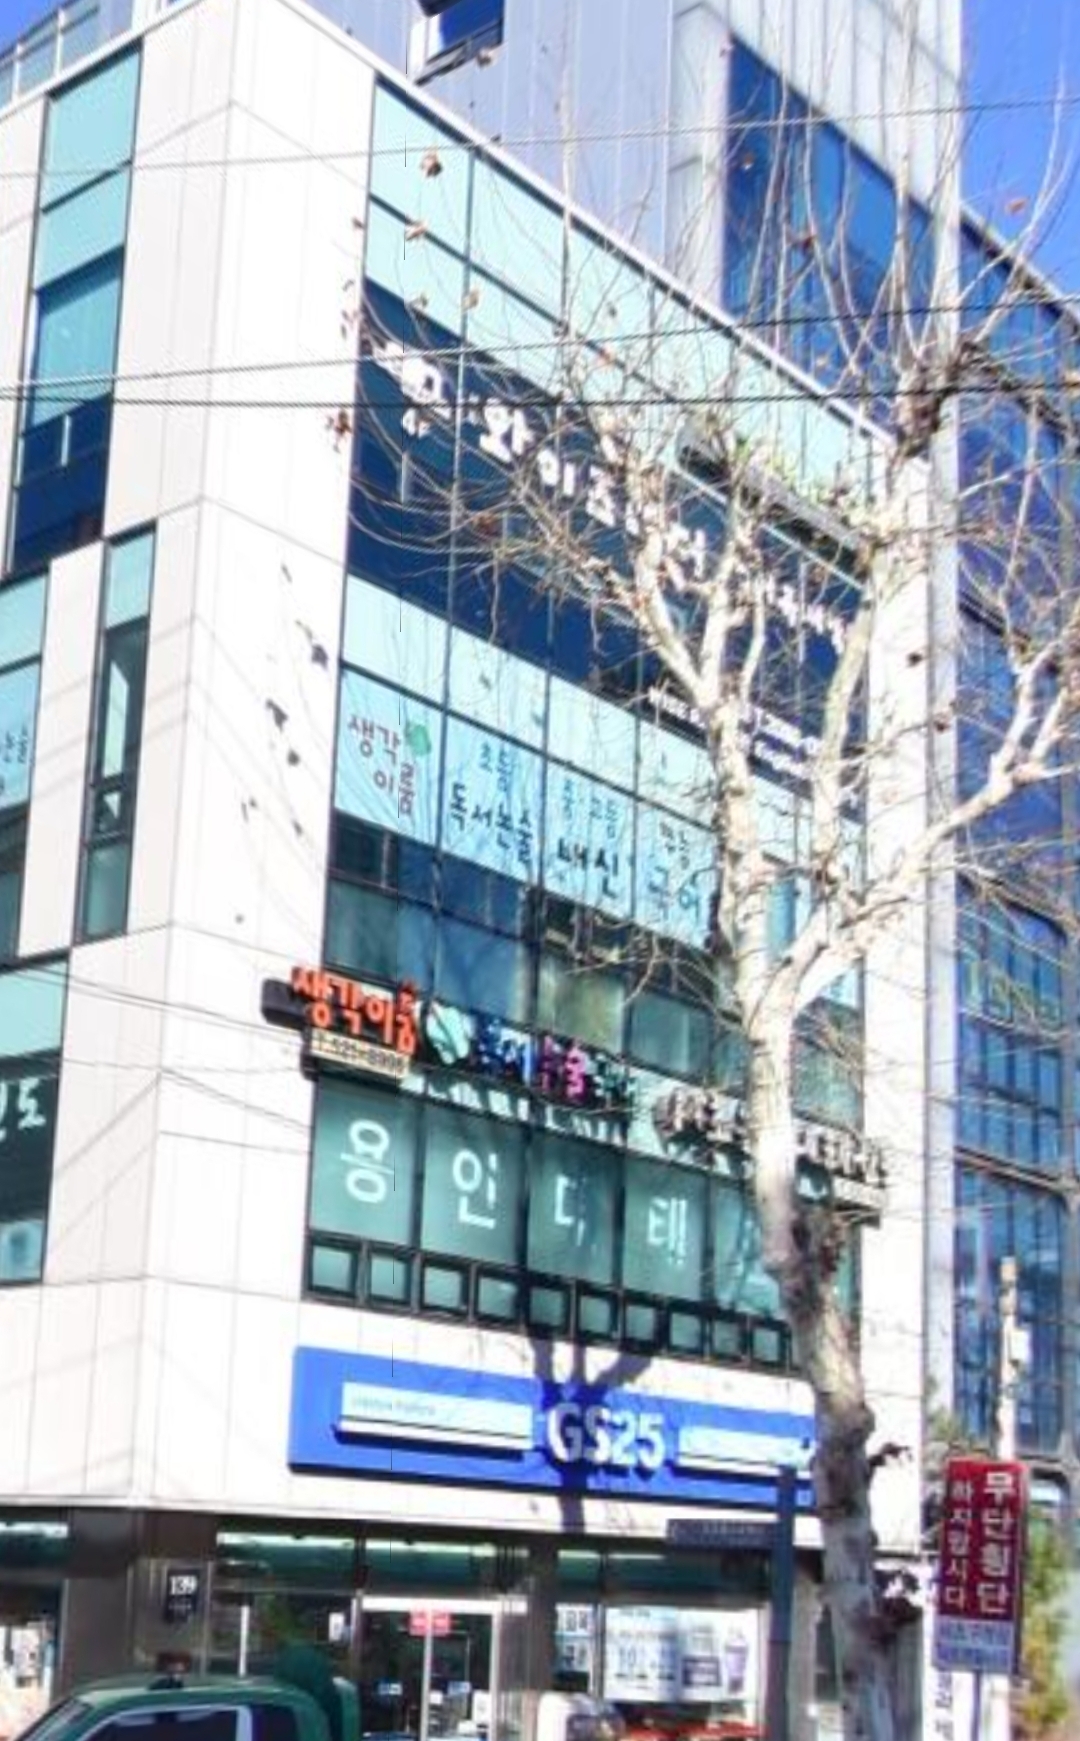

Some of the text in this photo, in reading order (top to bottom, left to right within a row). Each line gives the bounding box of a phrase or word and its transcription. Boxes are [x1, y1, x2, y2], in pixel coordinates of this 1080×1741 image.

[348, 715, 402, 765] 생각
[450, 782, 534, 866] 독서논술
[556, 835, 619, 900] 내신
[548, 1402, 666, 1470] GS25
[170, 1575, 198, 1596] 139
